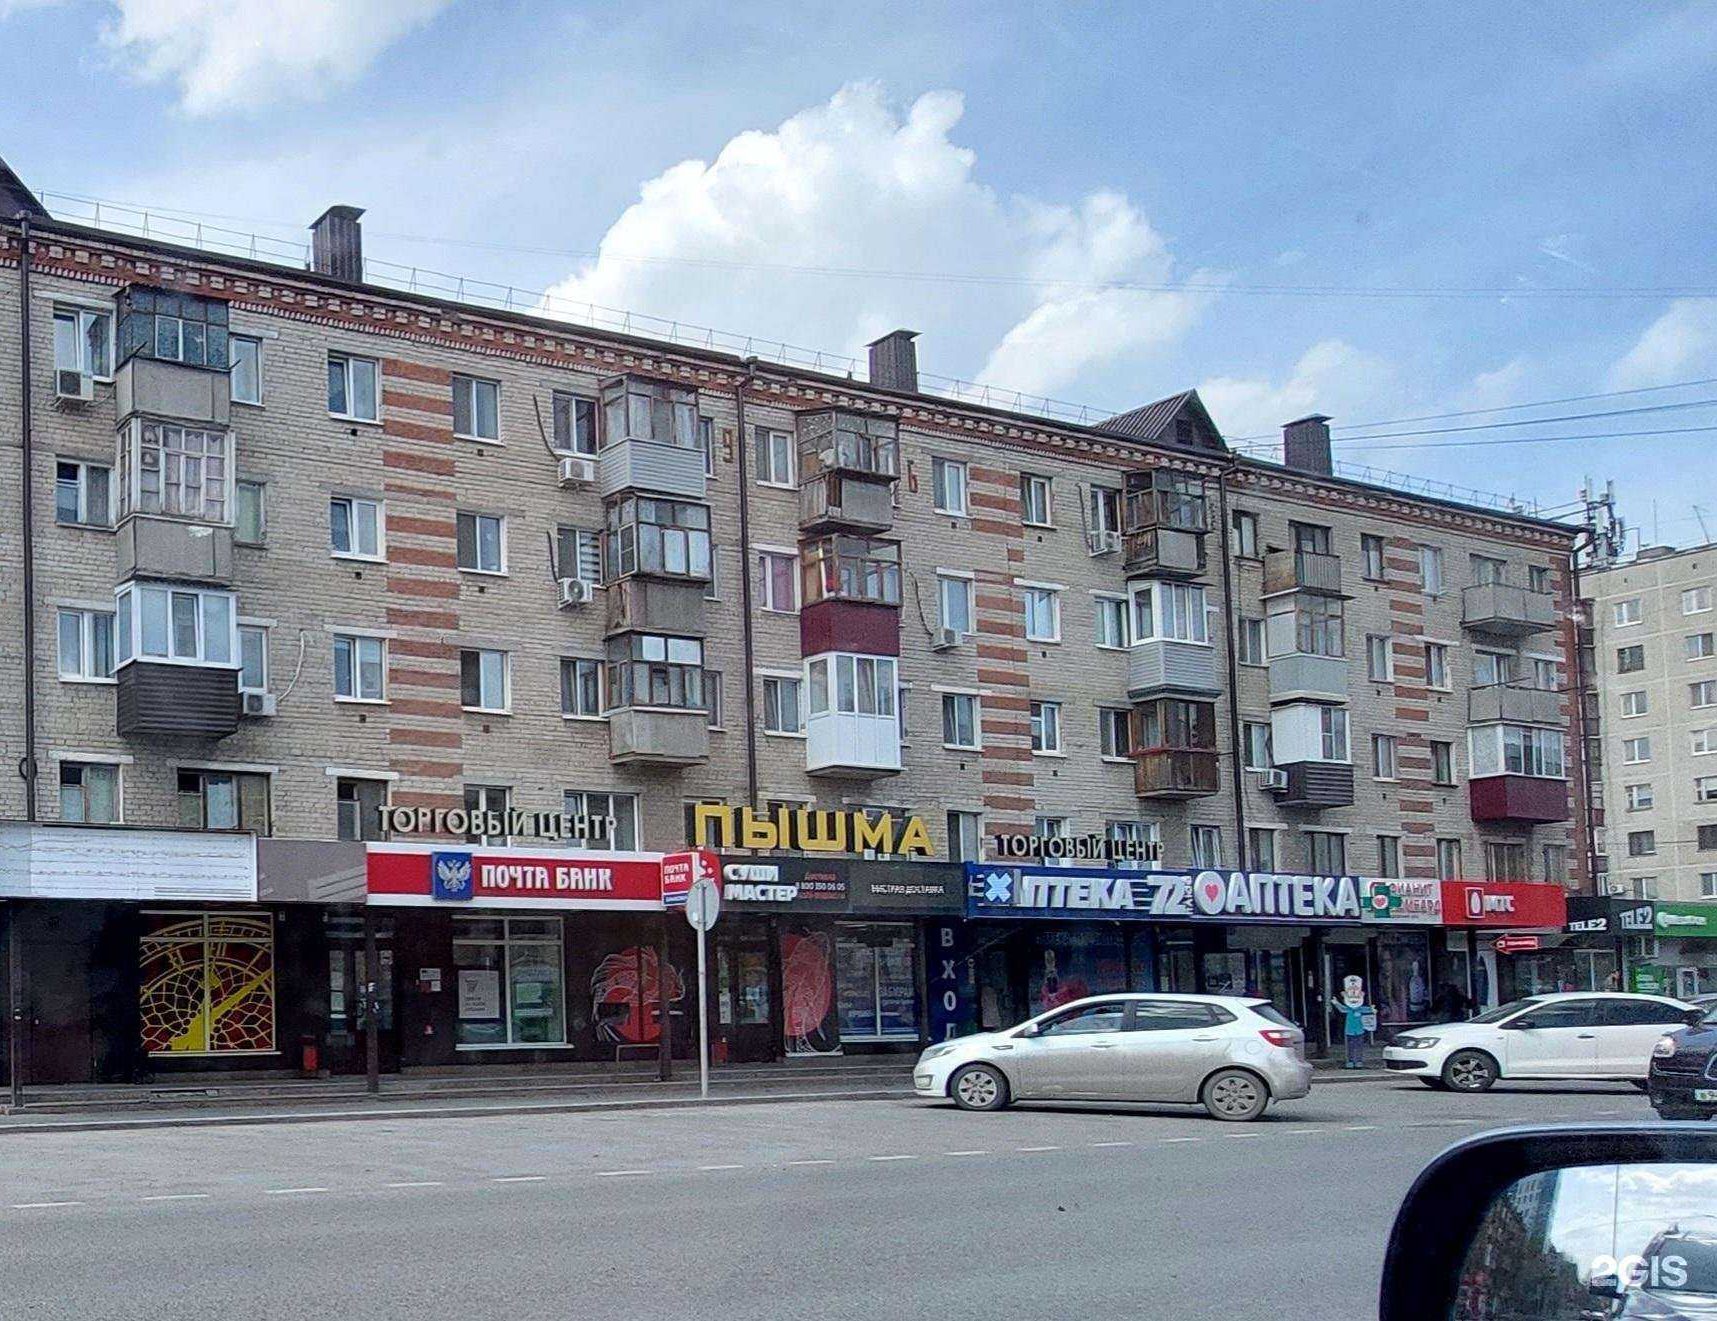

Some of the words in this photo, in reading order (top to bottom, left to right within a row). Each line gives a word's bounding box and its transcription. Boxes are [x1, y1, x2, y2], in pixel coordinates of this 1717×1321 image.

[378, 805, 532, 837] ТОРГОВЫЙ
[538, 811, 618, 841] ЦЕНТР
[693, 804, 935, 856] ПЫШМА
[1000, 834, 1106, 860] ТОРГОВЫЙ
[1111, 838, 1165, 862] ЦЕНТР
[481, 864, 550, 889] ПОЧТА
[555, 867, 614, 891] БАНК
[724, 883, 798, 902] МАСТЕР
[1020, 875, 1134, 909] ПТЕКА
[1225, 871, 1360, 917] АПТЕКА
[1568, 917, 1608, 931] TELE2
